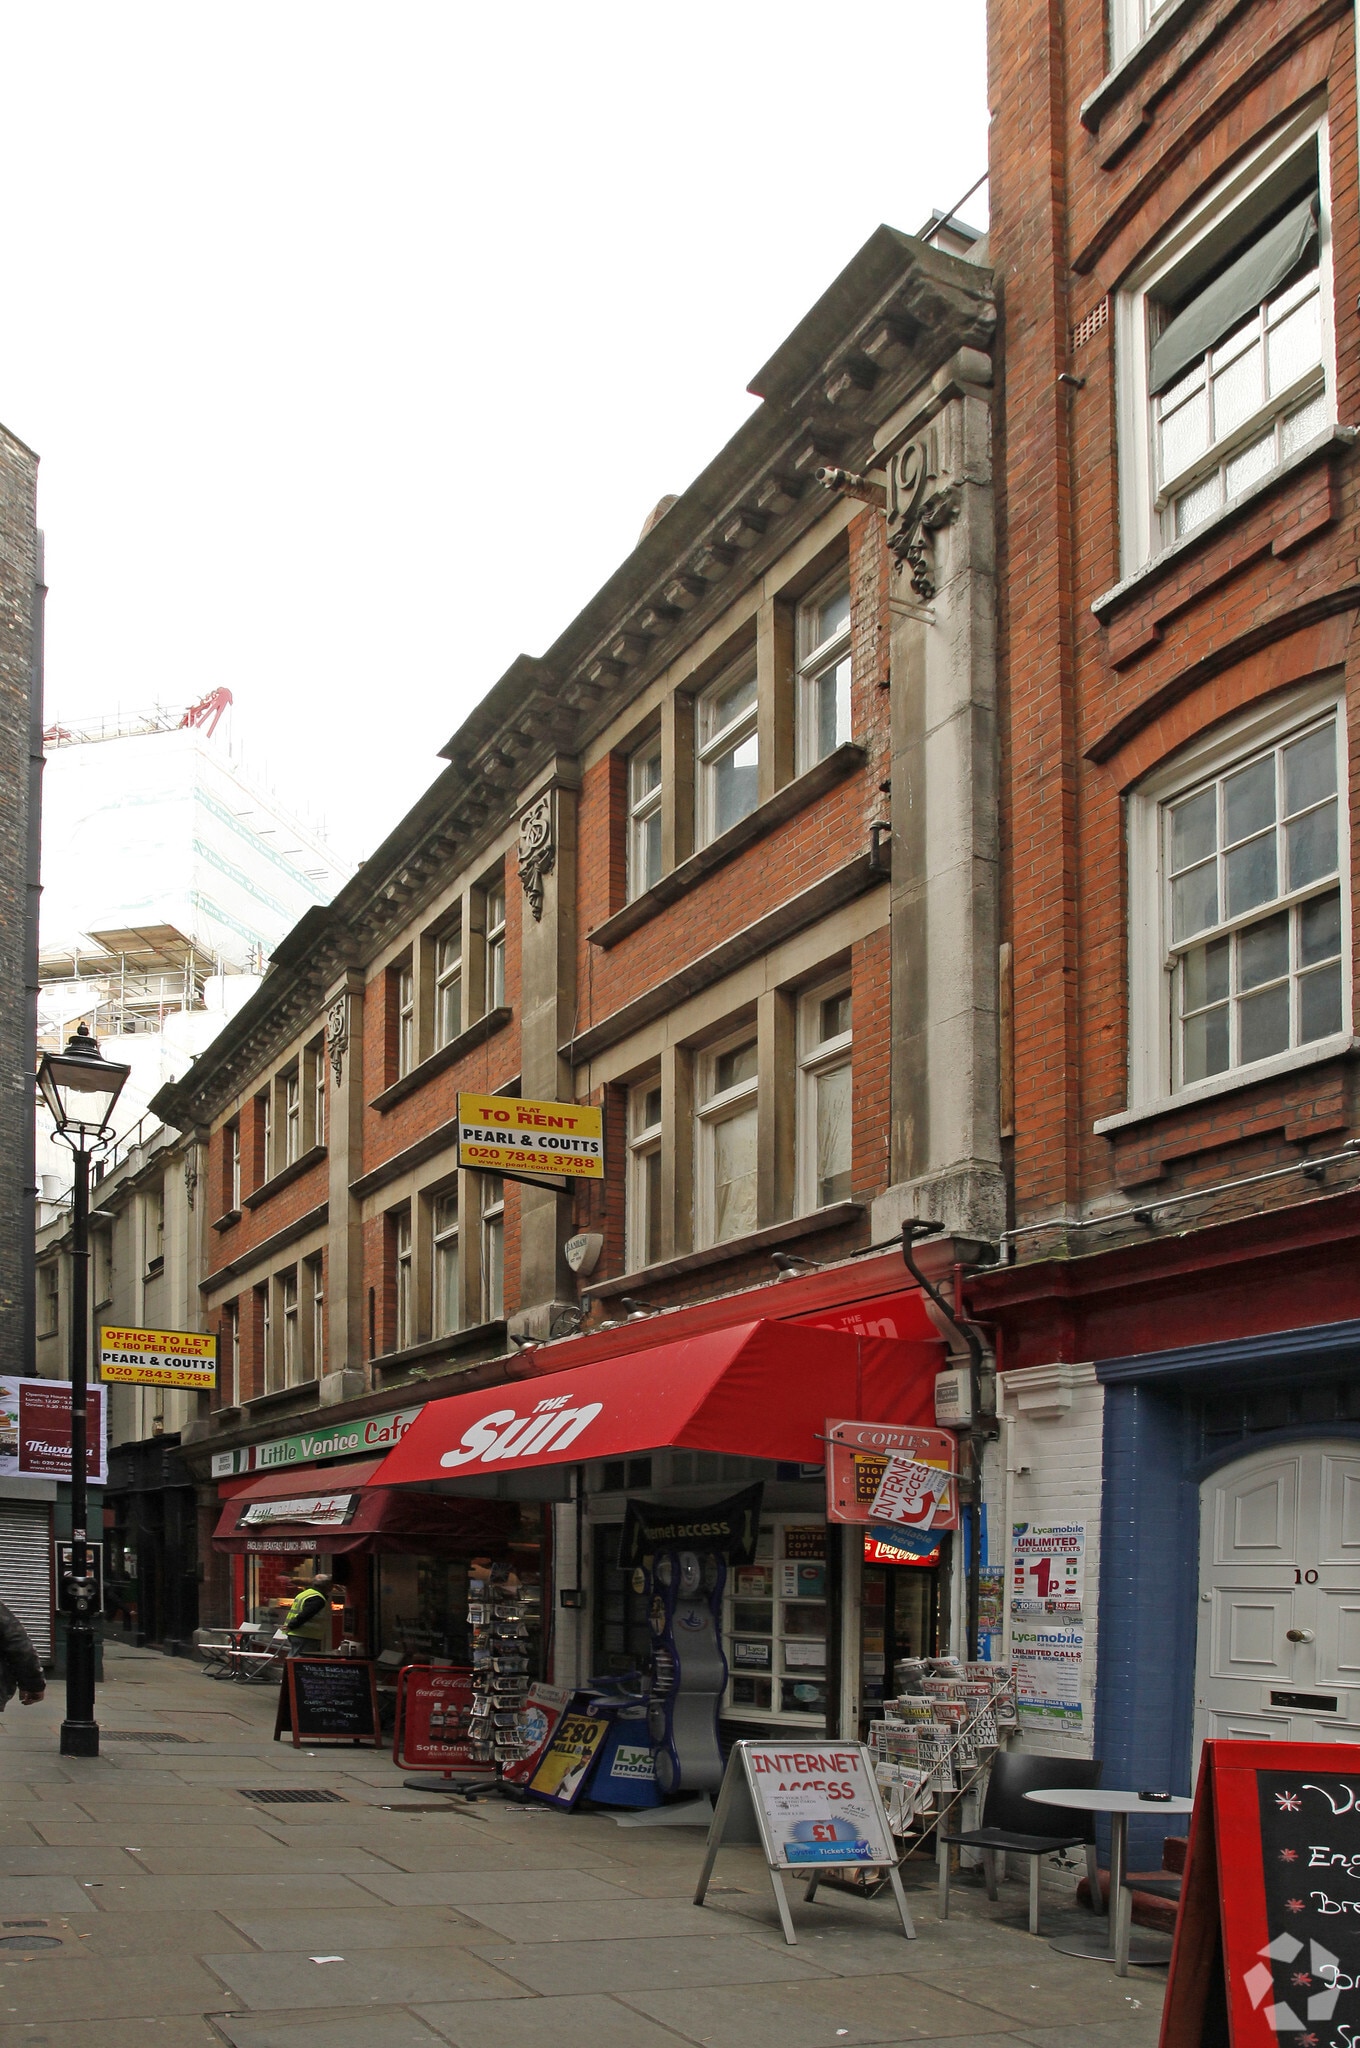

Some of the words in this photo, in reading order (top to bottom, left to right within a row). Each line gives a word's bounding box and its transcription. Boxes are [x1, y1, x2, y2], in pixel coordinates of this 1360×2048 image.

[515, 1106, 541, 1114] FLAT
[479, 1109, 510, 1122] TO
[517, 1112, 578, 1129] RENT
[463, 1128, 516, 1145] PEARL
[520, 1134, 533, 1146] &
[538, 1136, 599, 1153] COUTTS
[468, 1147, 500, 1159] 020
[505, 1150, 549, 1164] 7843
[554, 1155, 595, 1169] 3788
[477, 1159, 586, 1175] www.pearl-coutts.co.uk
[841, 1314, 863, 1325] THE
[106, 1331, 157, 1343] OFFICE
[161, 1335, 180, 1344] TO
[184, 1337, 211, 1347] LET
[144, 1343, 167, 1352] PER
[170, 1346, 203, 1356] WEEK
[102, 1352, 146, 1365] PEARL
[150, 1356, 160, 1366] &
[164, 1357, 215, 1370] COUTTS
[106, 1366, 132, 1376] 020
[137, 1369, 172, 1379] 7843
[177, 1372, 211, 1382] 3788
[532, 1393, 574, 1414] THE
[440, 1402, 604, 1468] Sun
[857, 1431, 931, 1448] COPIES
[25, 1440, 93, 1457] Thiwaa
[261, 1442, 296, 1466] Little
[300, 1432, 359, 1458] Venice
[858, 1466, 884, 1474] DIGI
[859, 1476, 881, 1484] COP
[873, 1457, 916, 1518] INTERNE
[902, 1464, 930, 1506] ACCES
[859, 1486, 878, 1494] CEN
[678, 1521, 731, 1537] access
[1032, 1525, 1084, 1535] Lycamobile
[788, 1541, 814, 1549] COPY
[890, 1532, 915, 1547] here
[1018, 1537, 1077, 1547] UNLIMITED
[1294, 1569, 1319, 1585] 10
[1012, 1631, 1083, 1644] Lycamobile
[1012, 1648, 1052, 1657] UNLIMITED
[1053, 1650, 1082, 1658] CALLS
[925, 1683, 949, 1692] Sun
[956, 1685, 990, 1696] Mirror
[558, 1722, 599, 1745] £80
[885, 1725, 910, 1733] RACING
[416, 1744, 438, 1752] Soft
[752, 1753, 860, 1774] INTERNET
[812, 1824, 837, 1841] £1
[791, 1848, 816, 1856] oyster
[819, 1847, 846, 1855] Ticket
[847, 1847, 866, 1855] Stop
